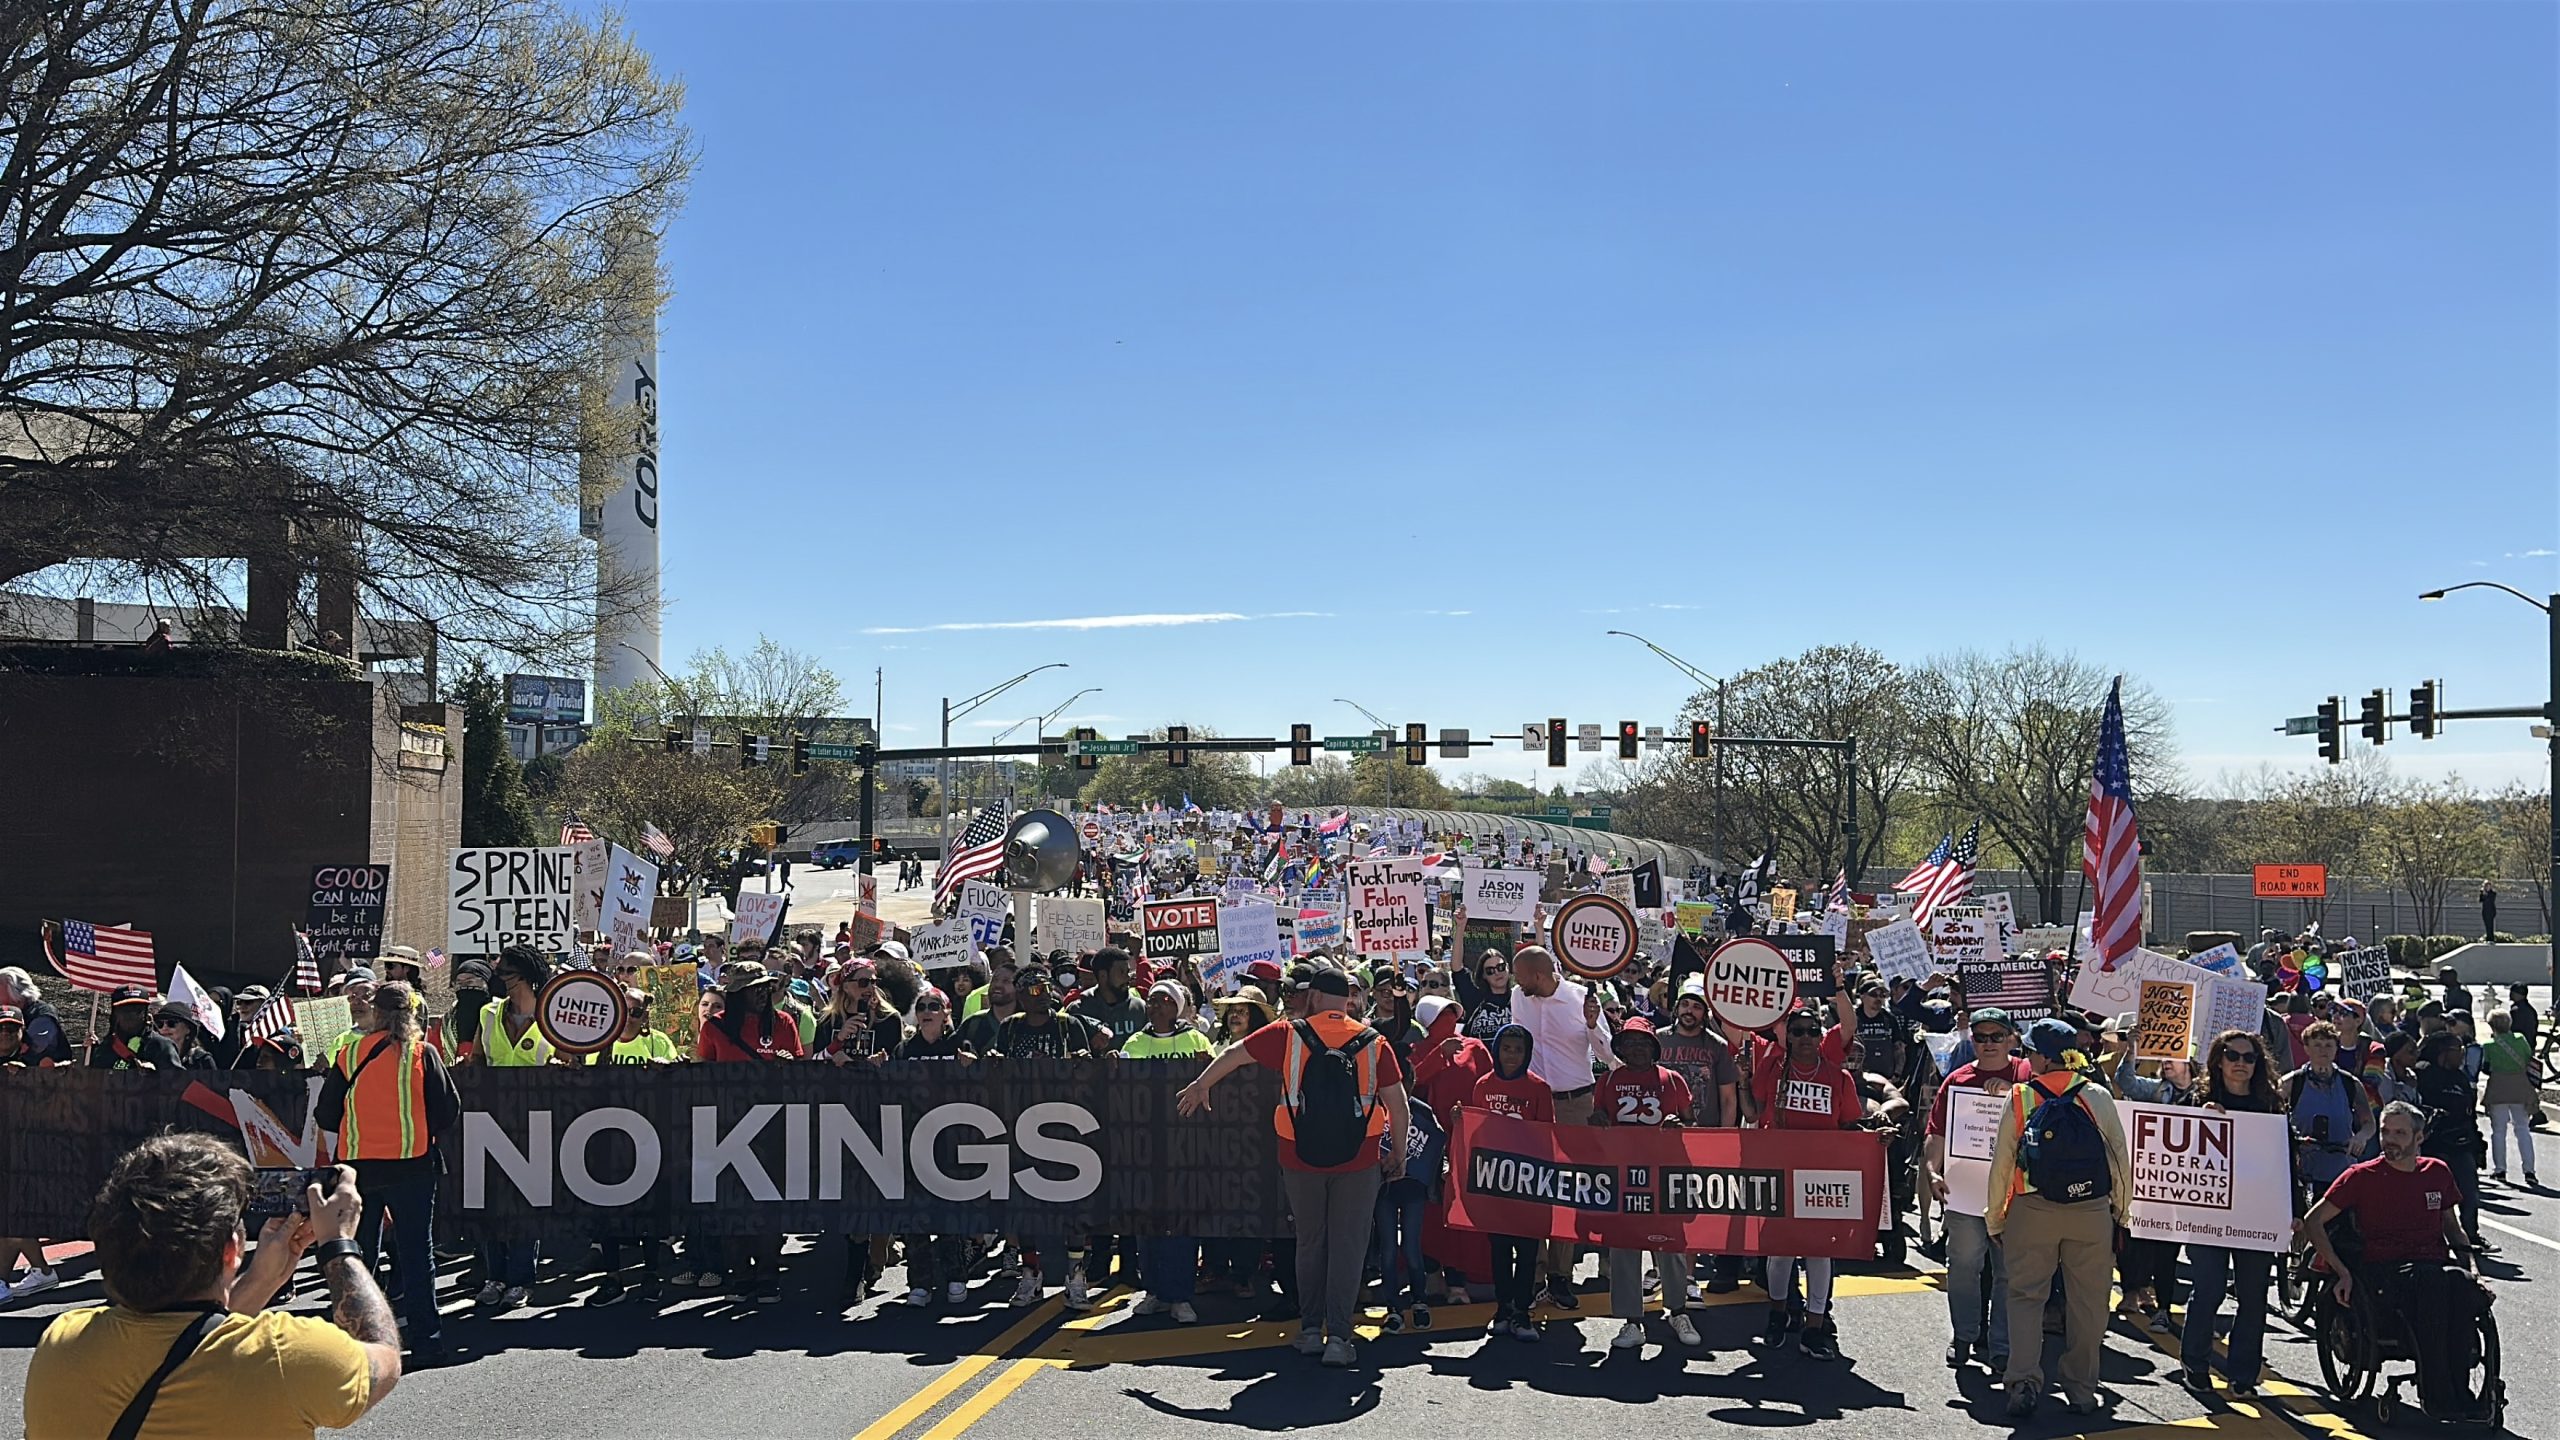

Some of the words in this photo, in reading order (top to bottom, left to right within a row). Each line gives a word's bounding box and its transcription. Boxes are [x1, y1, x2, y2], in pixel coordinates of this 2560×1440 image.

[1089, 743, 1107, 752] Jesse
[1109, 743, 1120, 751] Hill
[1123, 743, 1130, 751] Jr
[1325, 740, 1349, 749] Capitol
[1351, 740, 1359, 749] Sq
[315, 867, 385, 891] GOOD
[1349, 864, 1384, 887] Fuck
[1382, 864, 1423, 887] Trump
[2279, 868, 2299, 878] END
[623, 882, 638, 896] NO
[1479, 879, 1524, 892] JASON
[2260, 882, 2286, 891] ROAD
[2291, 882, 2320, 891] WORK
[312, 889, 343, 904] CAN
[350, 890, 382, 904] WIN
[967, 888, 1007, 908] FUCK
[1364, 887, 1407, 908] Felon
[1478, 890, 1524, 900] ESTEVES
[737, 897, 768, 913] LOVE
[1041, 900, 1095, 926] RELEASE
[1934, 907, 1984, 918] ACTIVATE
[331, 908, 348, 923] be
[354, 908, 367, 924] it
[454, 897, 571, 935] STEEN
[736, 912, 753, 926] WILL
[1146, 905, 1211, 928] VOTE
[1353, 906, 1418, 934] Pedophile
[305, 923, 350, 937] believe
[352, 923, 365, 936] in
[369, 923, 381, 936] it
[1063, 926, 1104, 940] EPSTEIN
[1571, 922, 1620, 940] UNITE
[1943, 922, 1960, 933] 26
[313, 938, 341, 958] fight
[344, 938, 359, 952] for
[360, 938, 371, 952] it
[472, 932, 564, 952] 4-PRES
[1054, 940, 1089, 955] FILES
[1147, 933, 1195, 952] TODAY!
[1360, 926, 1419, 952] Fascist
[1570, 936, 1618, 954] HERE!
[1225, 950, 1275, 969] DEMOCRACY
[1805, 948, 1816, 962] IS
[2343, 953, 2358, 966] NO
[2358, 950, 2388, 965] MORE
[1714, 961, 1790, 989] UNITE
[1962, 961, 2047, 974] PRO-AMERICA
[2344, 965, 2382, 980] KINGS
[2382, 964, 2391, 977] &
[1711, 982, 1786, 1012] HERE!
[2348, 983, 2363, 997] NO
[2362, 979, 2393, 996] MORE
[558, 996, 610, 1016] UNITE
[2006, 1007, 2052, 1019] TRUMP
[2140, 1000, 2189, 1020] Kings
[554, 1010, 605, 1030] HERE!
[2140, 1018, 2188, 1035] Since
[2140, 1033, 2185, 1051] 1776
[1675, 1047, 1714, 1061] KINGS
[1615, 1084, 1641, 1092] UNITE
[1485, 1094, 1508, 1102] UNITE
[1489, 1102, 1523, 1113] LOCAL
[1616, 1097, 1663, 1125] 23
[1964, 1123, 1984, 1132] Federal
[2136, 1114, 2229, 1158] FUN
[463, 1106, 662, 1209] NO
[690, 1102, 1103, 1204] KINGS
[2135, 1151, 2228, 1173] FEDERAL
[1476, 1154, 1613, 1207] WORKERS
[1629, 1168, 1647, 1186] TO
[2135, 1167, 2228, 1188] UNIONISTS
[1668, 1171, 1778, 1212] FRONT!
[1804, 1182, 1851, 1196] UNITE
[2134, 1183, 2227, 1206] NETWORK
[1625, 1194, 1652, 1213] THE
[1804, 1194, 1851, 1209] HERE!
[2131, 1215, 2173, 1232] Workers,
[2175, 1220, 2223, 1238] Defending
[2224, 1225, 2279, 1243] Democracy
